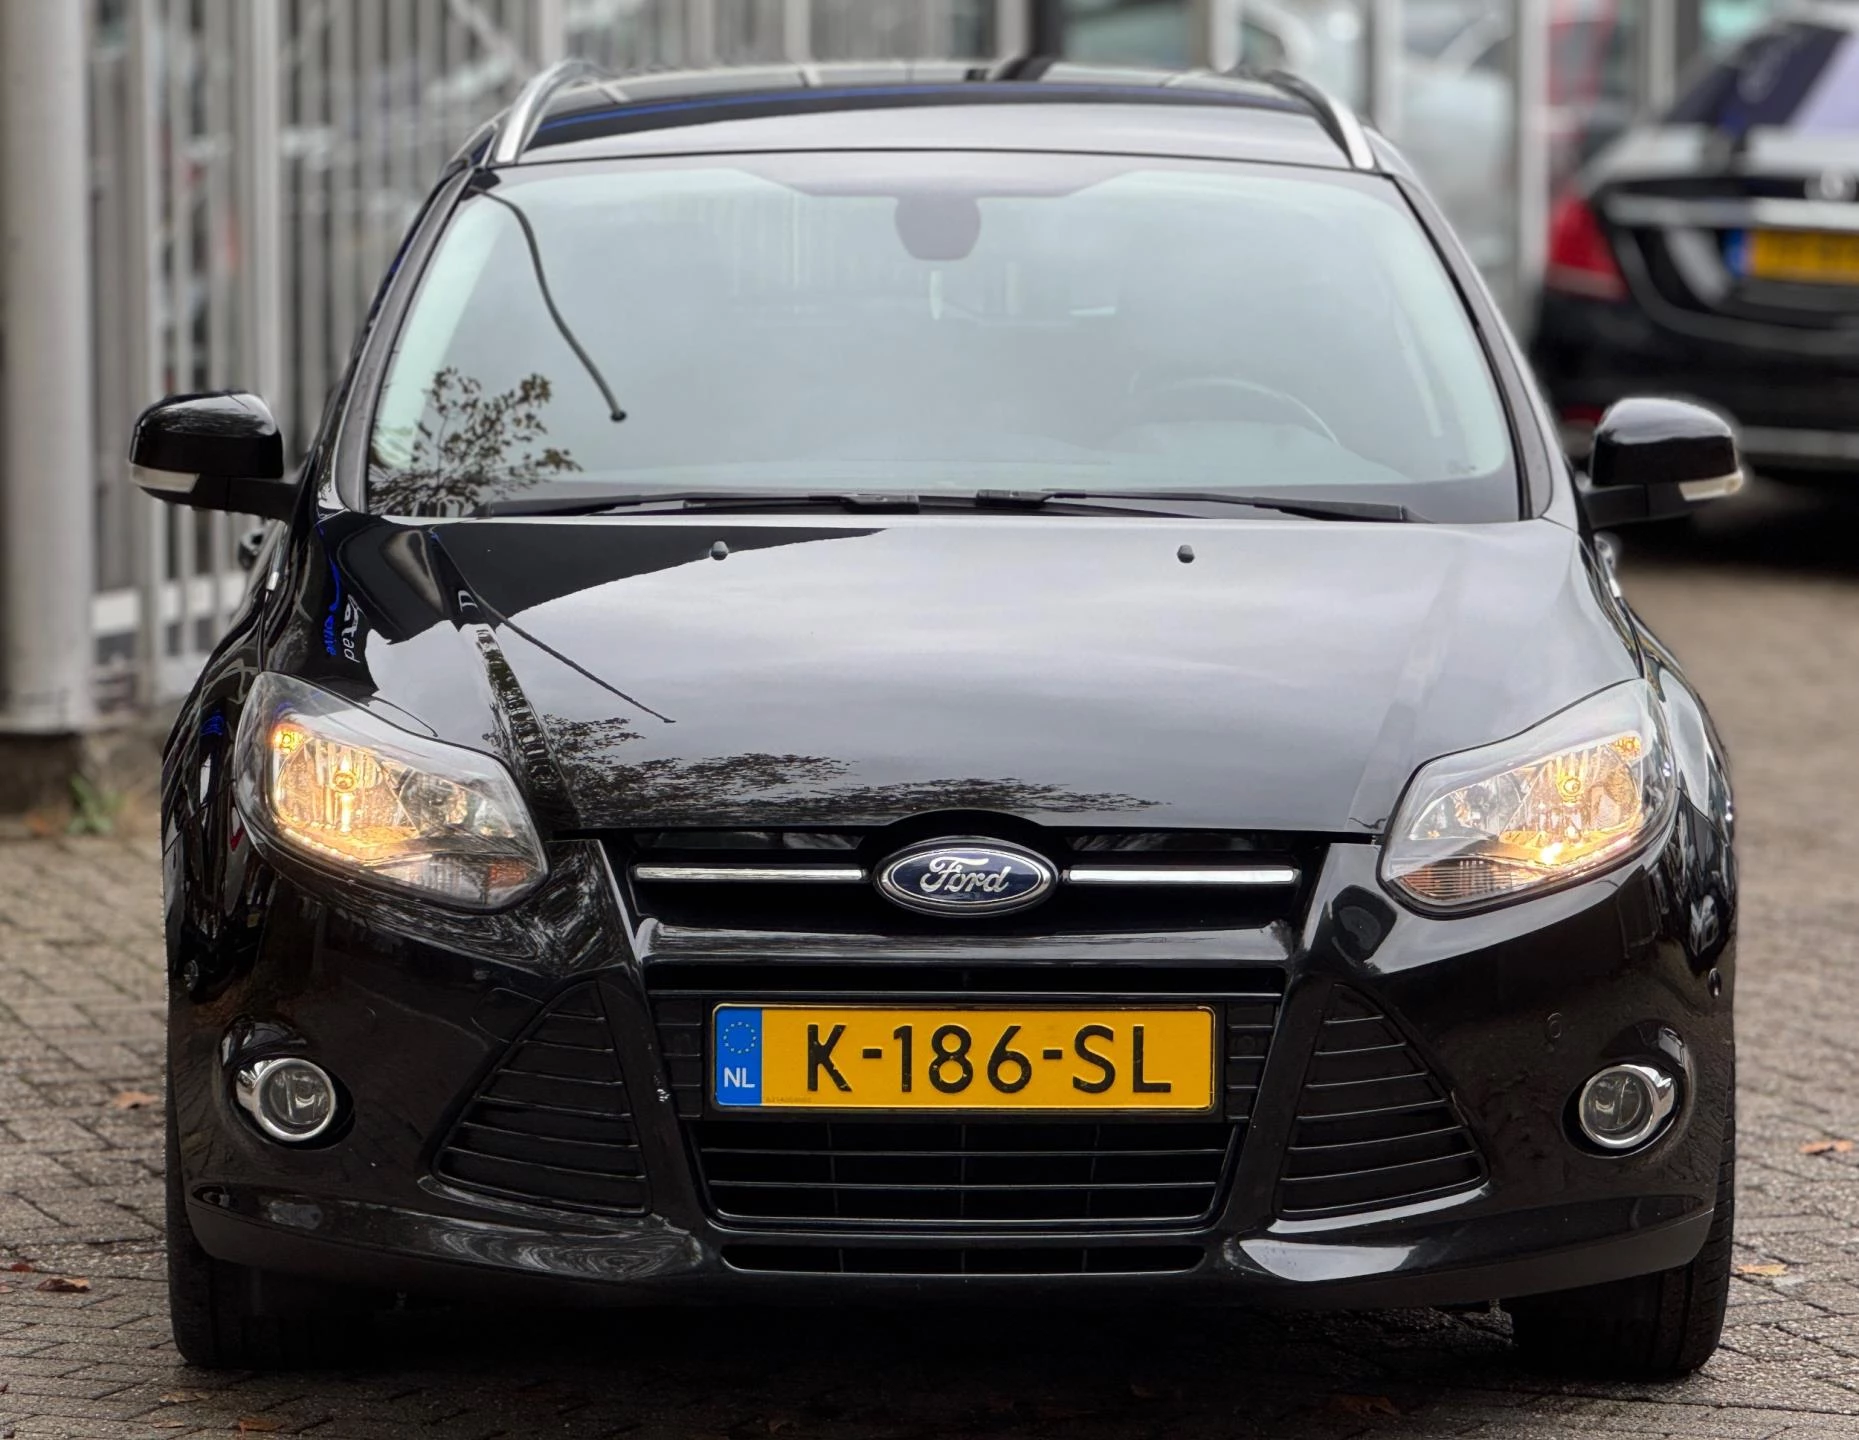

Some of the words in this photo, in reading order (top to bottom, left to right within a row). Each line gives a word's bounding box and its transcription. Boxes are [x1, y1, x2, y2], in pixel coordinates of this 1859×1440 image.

[919, 856, 1012, 893] Ford
[724, 1067, 755, 1088] NL
[807, 1024, 1172, 1094] K-186-SL
